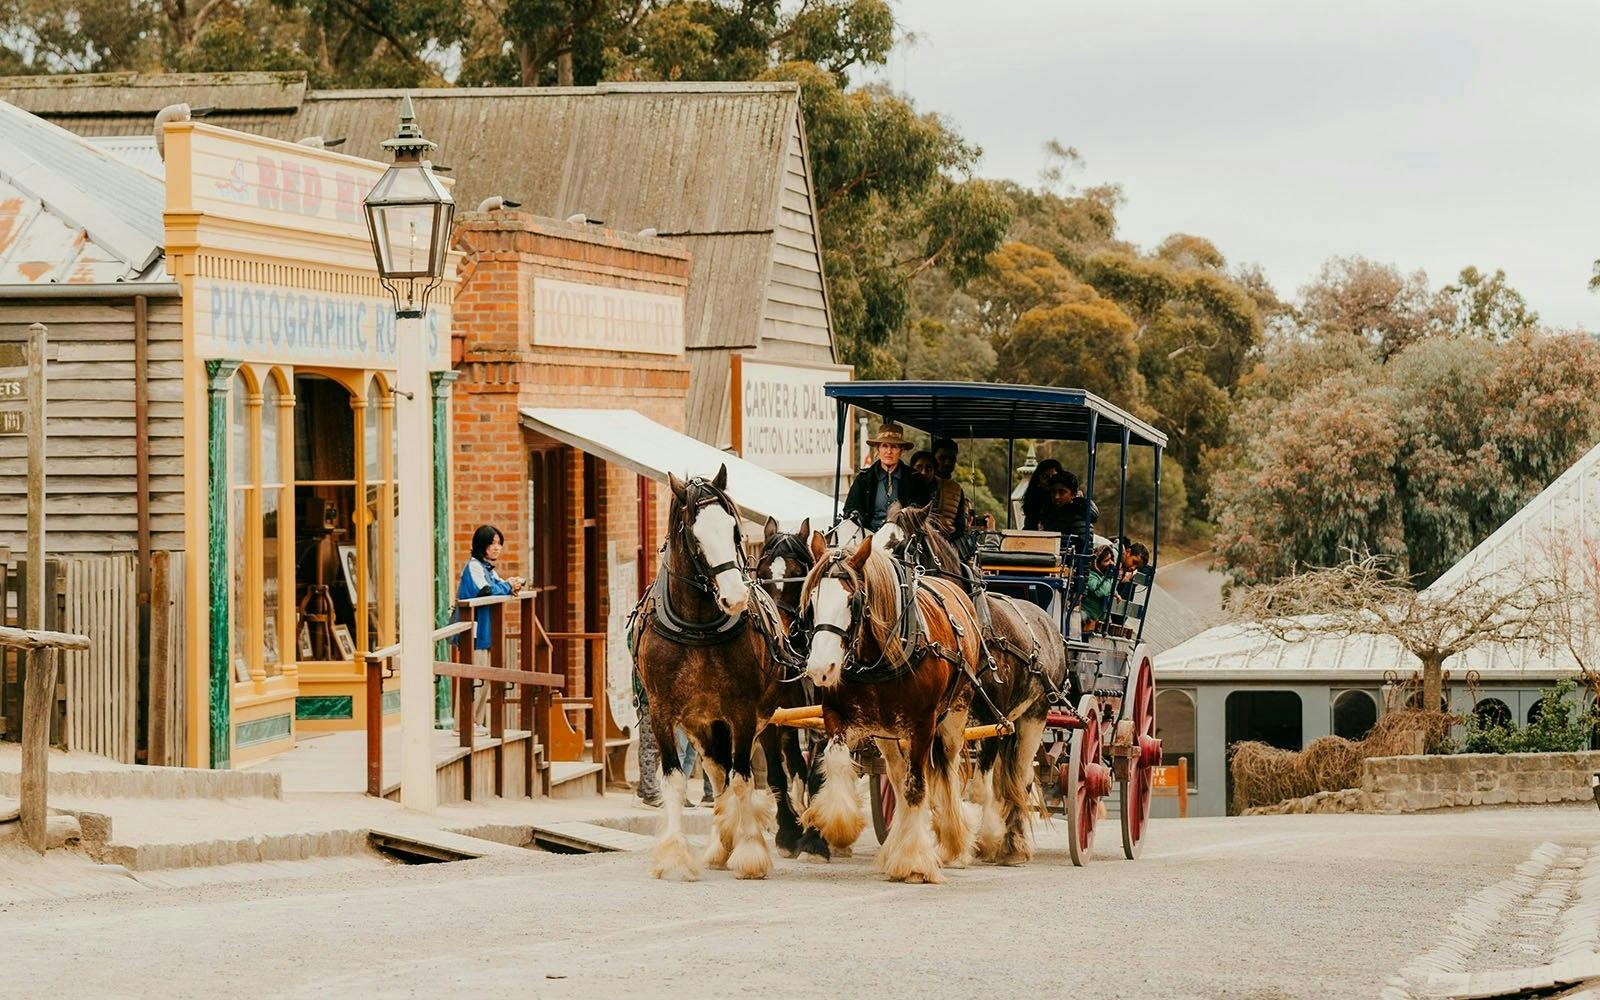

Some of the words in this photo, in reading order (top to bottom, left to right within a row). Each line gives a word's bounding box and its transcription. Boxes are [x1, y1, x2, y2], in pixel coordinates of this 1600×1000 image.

[257, 155, 322, 215] RED
[210, 283, 368, 354] PHOTOGRAPHIC
[375, 303, 438, 360] ROS
[539, 287, 597, 342] HOPE
[603, 295, 679, 348] BAKERY
[745, 380, 790, 418] CARVER
[792, 386, 799, 418] &
[803, 384, 837, 420] DALTO
[747, 426, 784, 454] AUCTION
[794, 428, 813, 454] SALE
